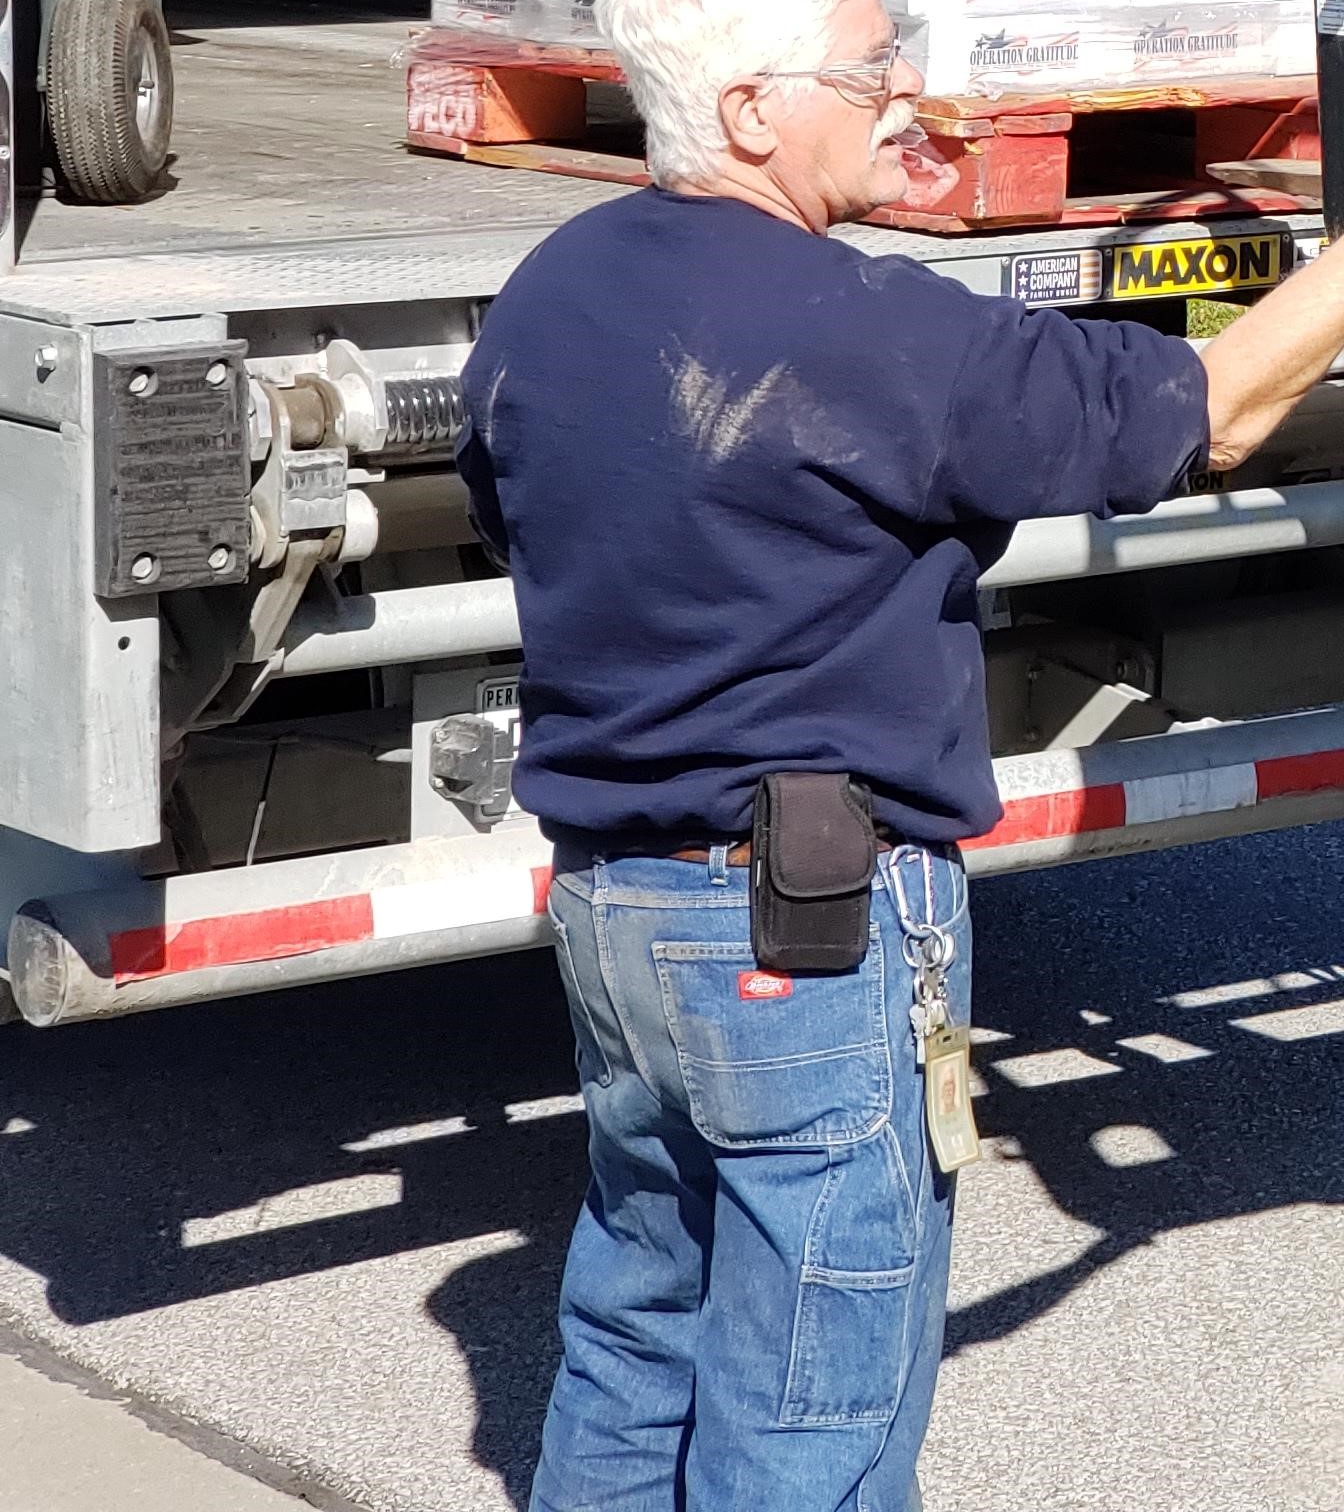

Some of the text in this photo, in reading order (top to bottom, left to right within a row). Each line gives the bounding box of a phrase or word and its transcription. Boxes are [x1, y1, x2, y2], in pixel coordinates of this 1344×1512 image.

[1133, 32, 1240, 55] OPERATION GRATITUDE
[970, 44, 1079, 67] OPERATION GRATITUDE
[1030, 256, 1078, 274] AMERICAN
[1118, 240, 1271, 291] MAXON
[1029, 270, 1078, 290] COMPANY
[1030, 291, 1053, 300] FAMILY
